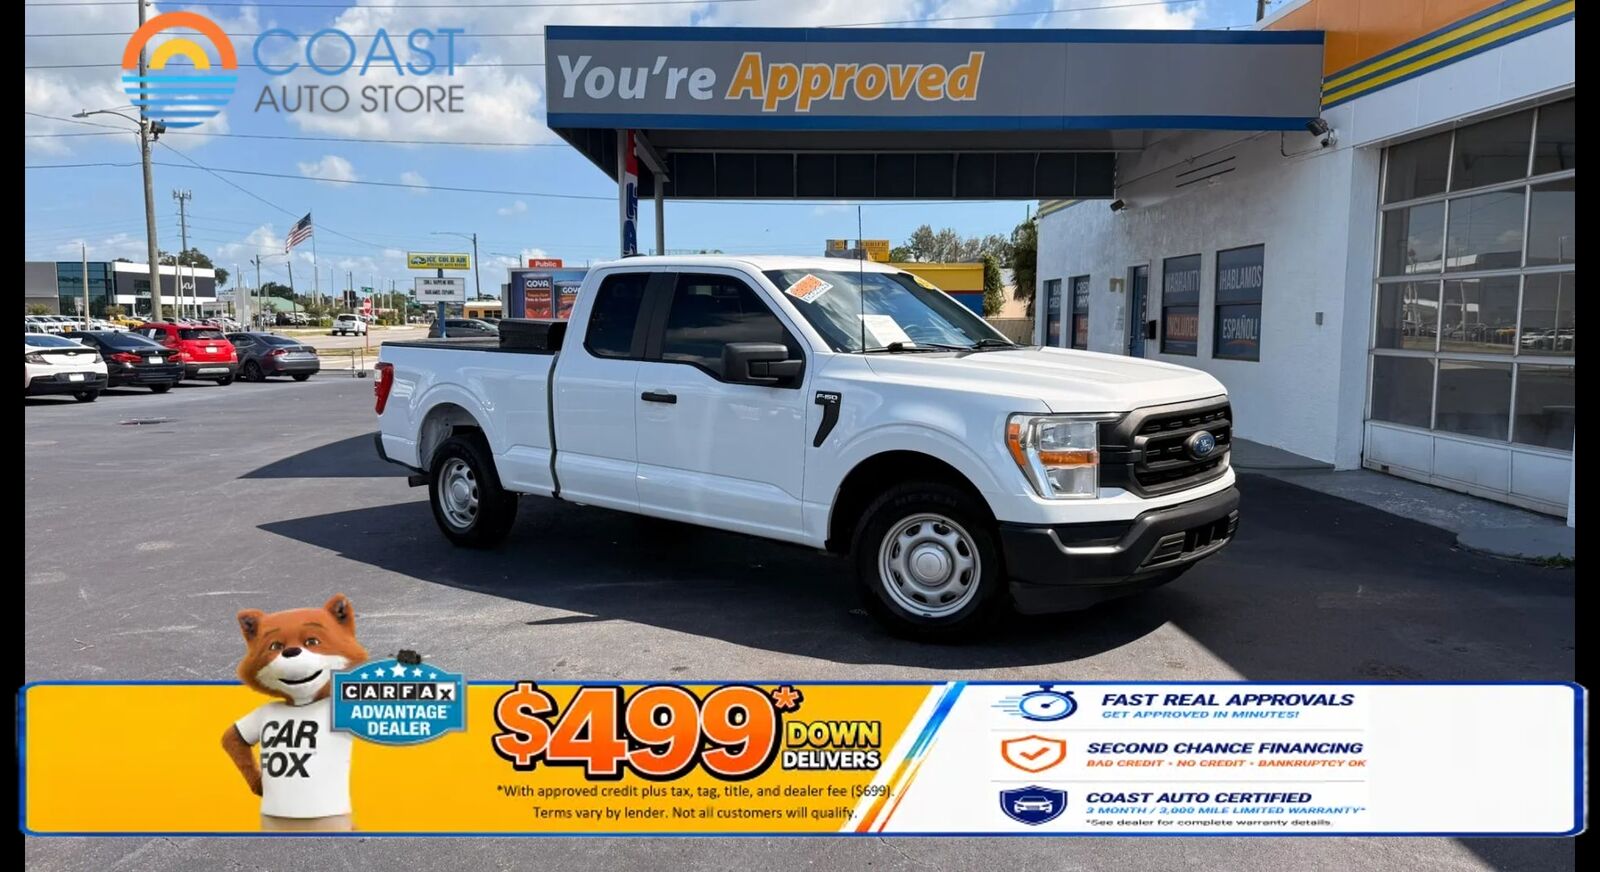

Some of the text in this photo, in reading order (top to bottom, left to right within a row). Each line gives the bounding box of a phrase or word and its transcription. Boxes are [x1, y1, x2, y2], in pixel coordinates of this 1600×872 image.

[557, 51, 985, 112] You're Approved
[526, 280, 548, 288] GOYA
[1165, 270, 1200, 293] WARRANTY
[1167, 314, 1198, 338] INCLUDED
[1222, 315, 1258, 339] ESPAÑOL!
